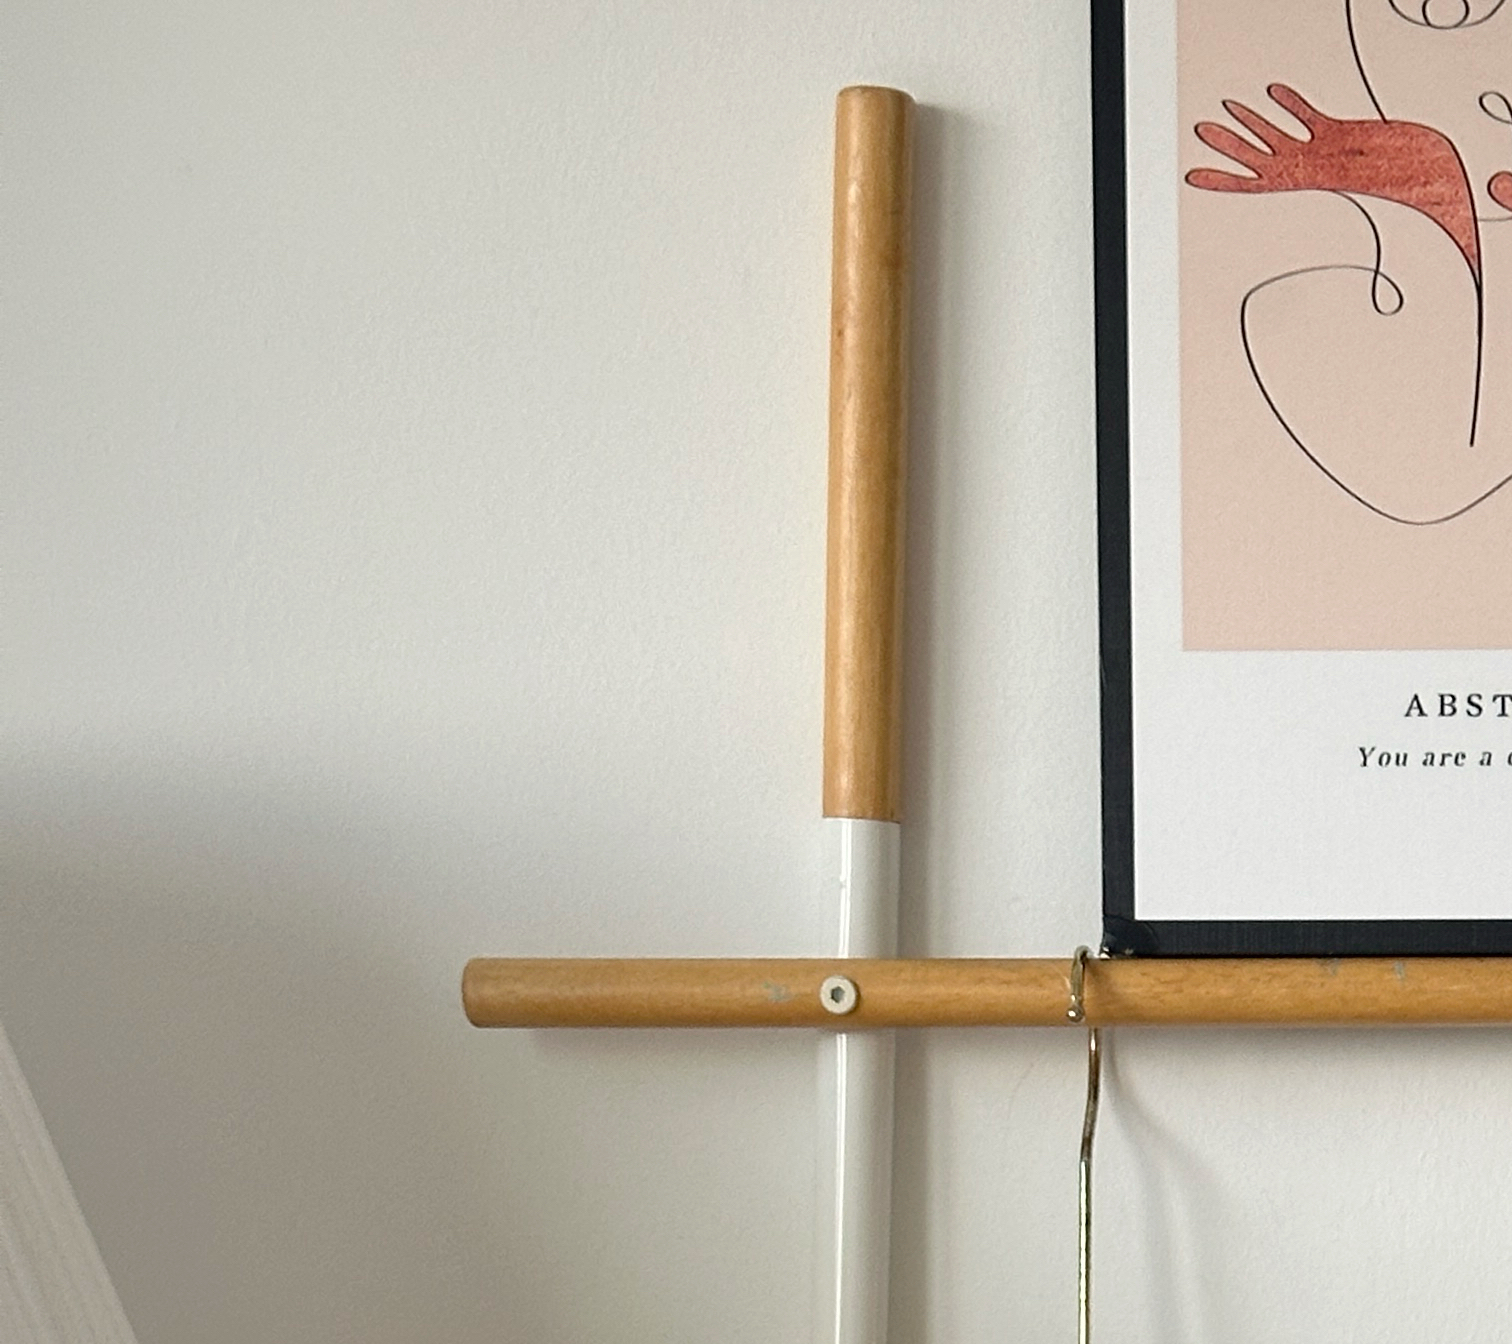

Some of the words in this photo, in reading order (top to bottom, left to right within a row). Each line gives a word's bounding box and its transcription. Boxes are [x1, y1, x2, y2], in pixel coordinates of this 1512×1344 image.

[1358, 746, 1408, 768] You
[1421, 751, 1468, 768] are
[1478, 751, 1493, 768] a
